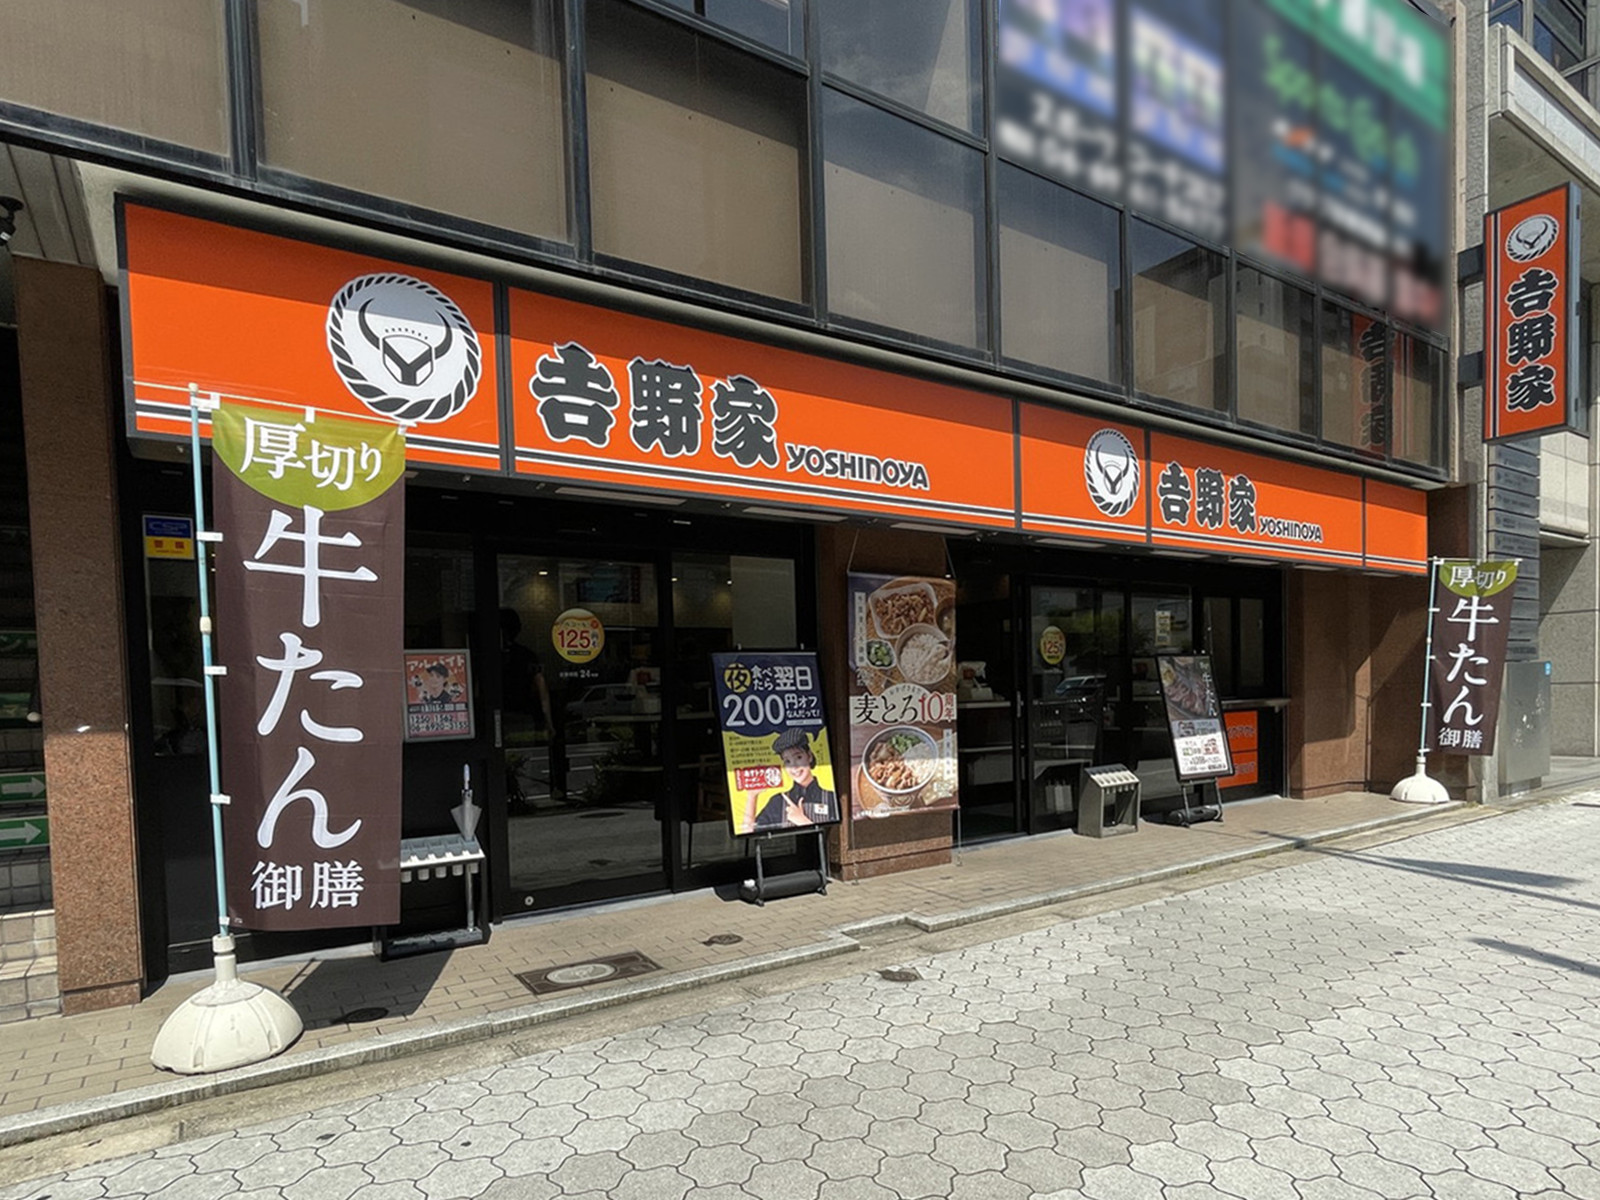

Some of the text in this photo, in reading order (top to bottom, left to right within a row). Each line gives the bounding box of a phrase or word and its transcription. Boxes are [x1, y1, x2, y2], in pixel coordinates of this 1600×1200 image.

[240, 416, 382, 491] 厚切り
[785, 443, 930, 491] YOSHINOYA
[1259, 516, 1323, 543] YOSHINOYA
[1449, 564, 1507, 590] 厚切り
[557, 629, 591, 649] 125
[1443, 595, 1499, 726] 牛たん
[243, 505, 378, 849] 牛たん
[1438, 727, 1483, 749] 御膳
[250, 859, 364, 910] 御膳
